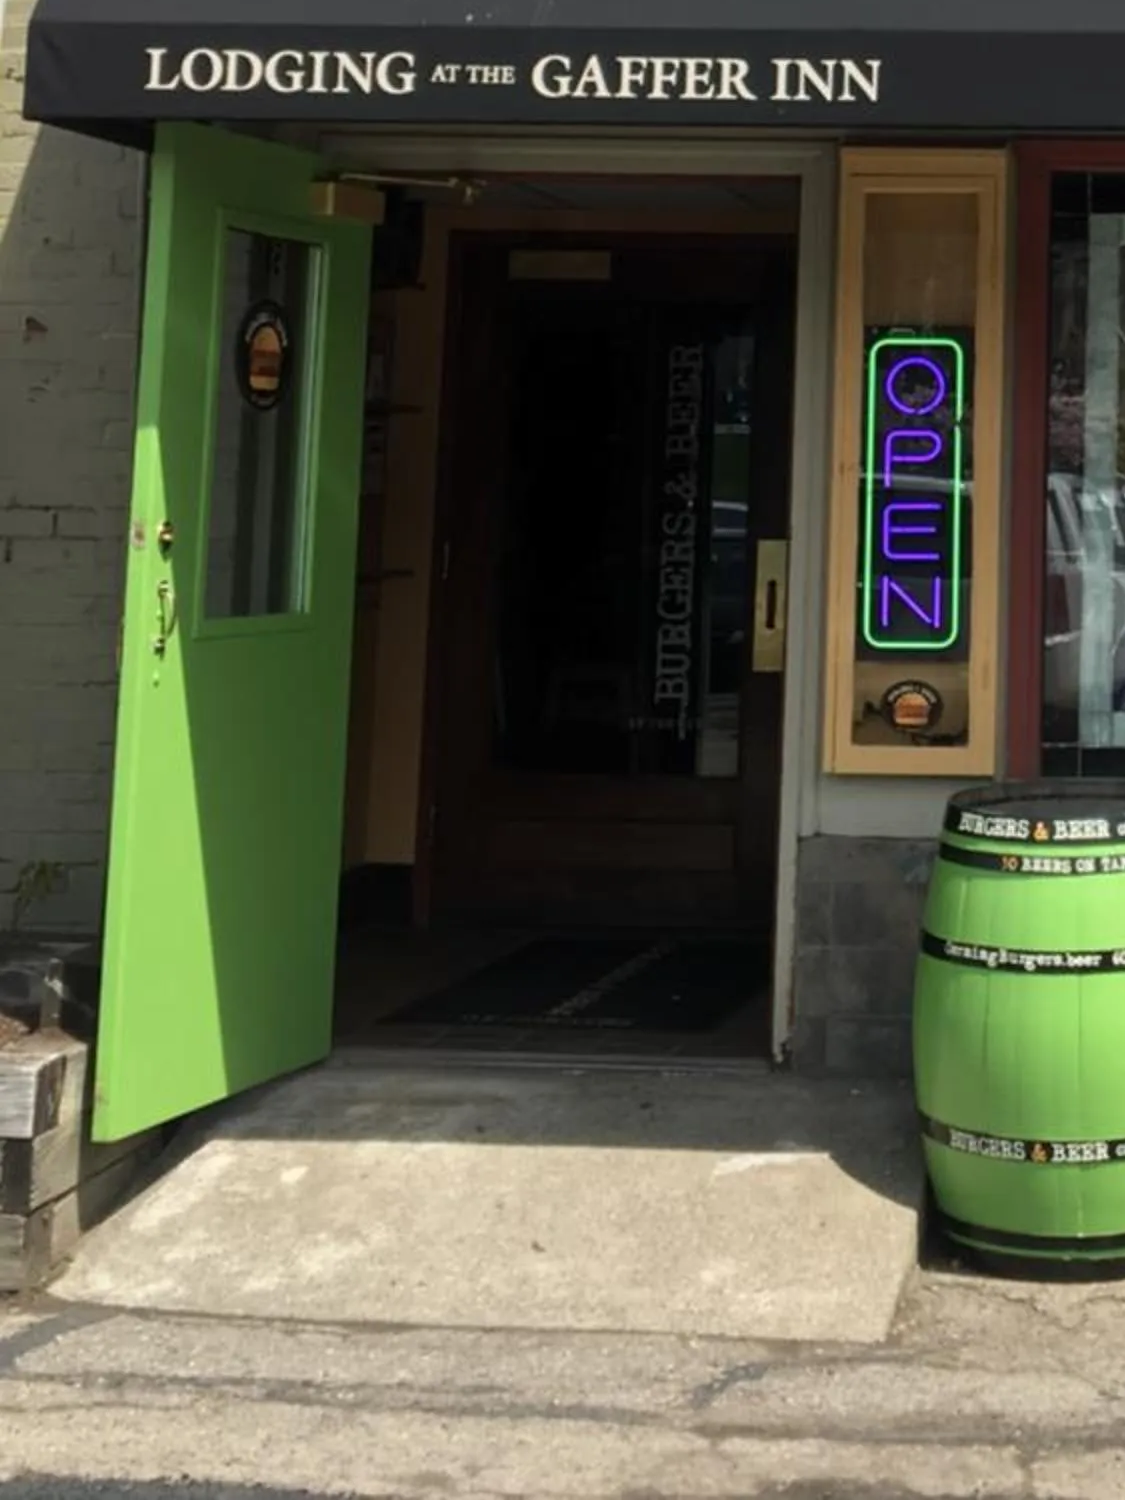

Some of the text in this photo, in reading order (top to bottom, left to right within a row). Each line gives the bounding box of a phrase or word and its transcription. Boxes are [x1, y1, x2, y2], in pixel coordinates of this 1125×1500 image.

[144, 47, 881, 102] LODGING AT THE GAFFER INN
[665, 343, 703, 459] BEER
[880, 356, 946, 630] OPEN
[654, 509, 698, 738] BURGERS
[1033, 820, 1050, 842] &
[1053, 818, 1111, 840] BEER
[1031, 1142, 1049, 1164] &
[1052, 1141, 1110, 1163] BEER
